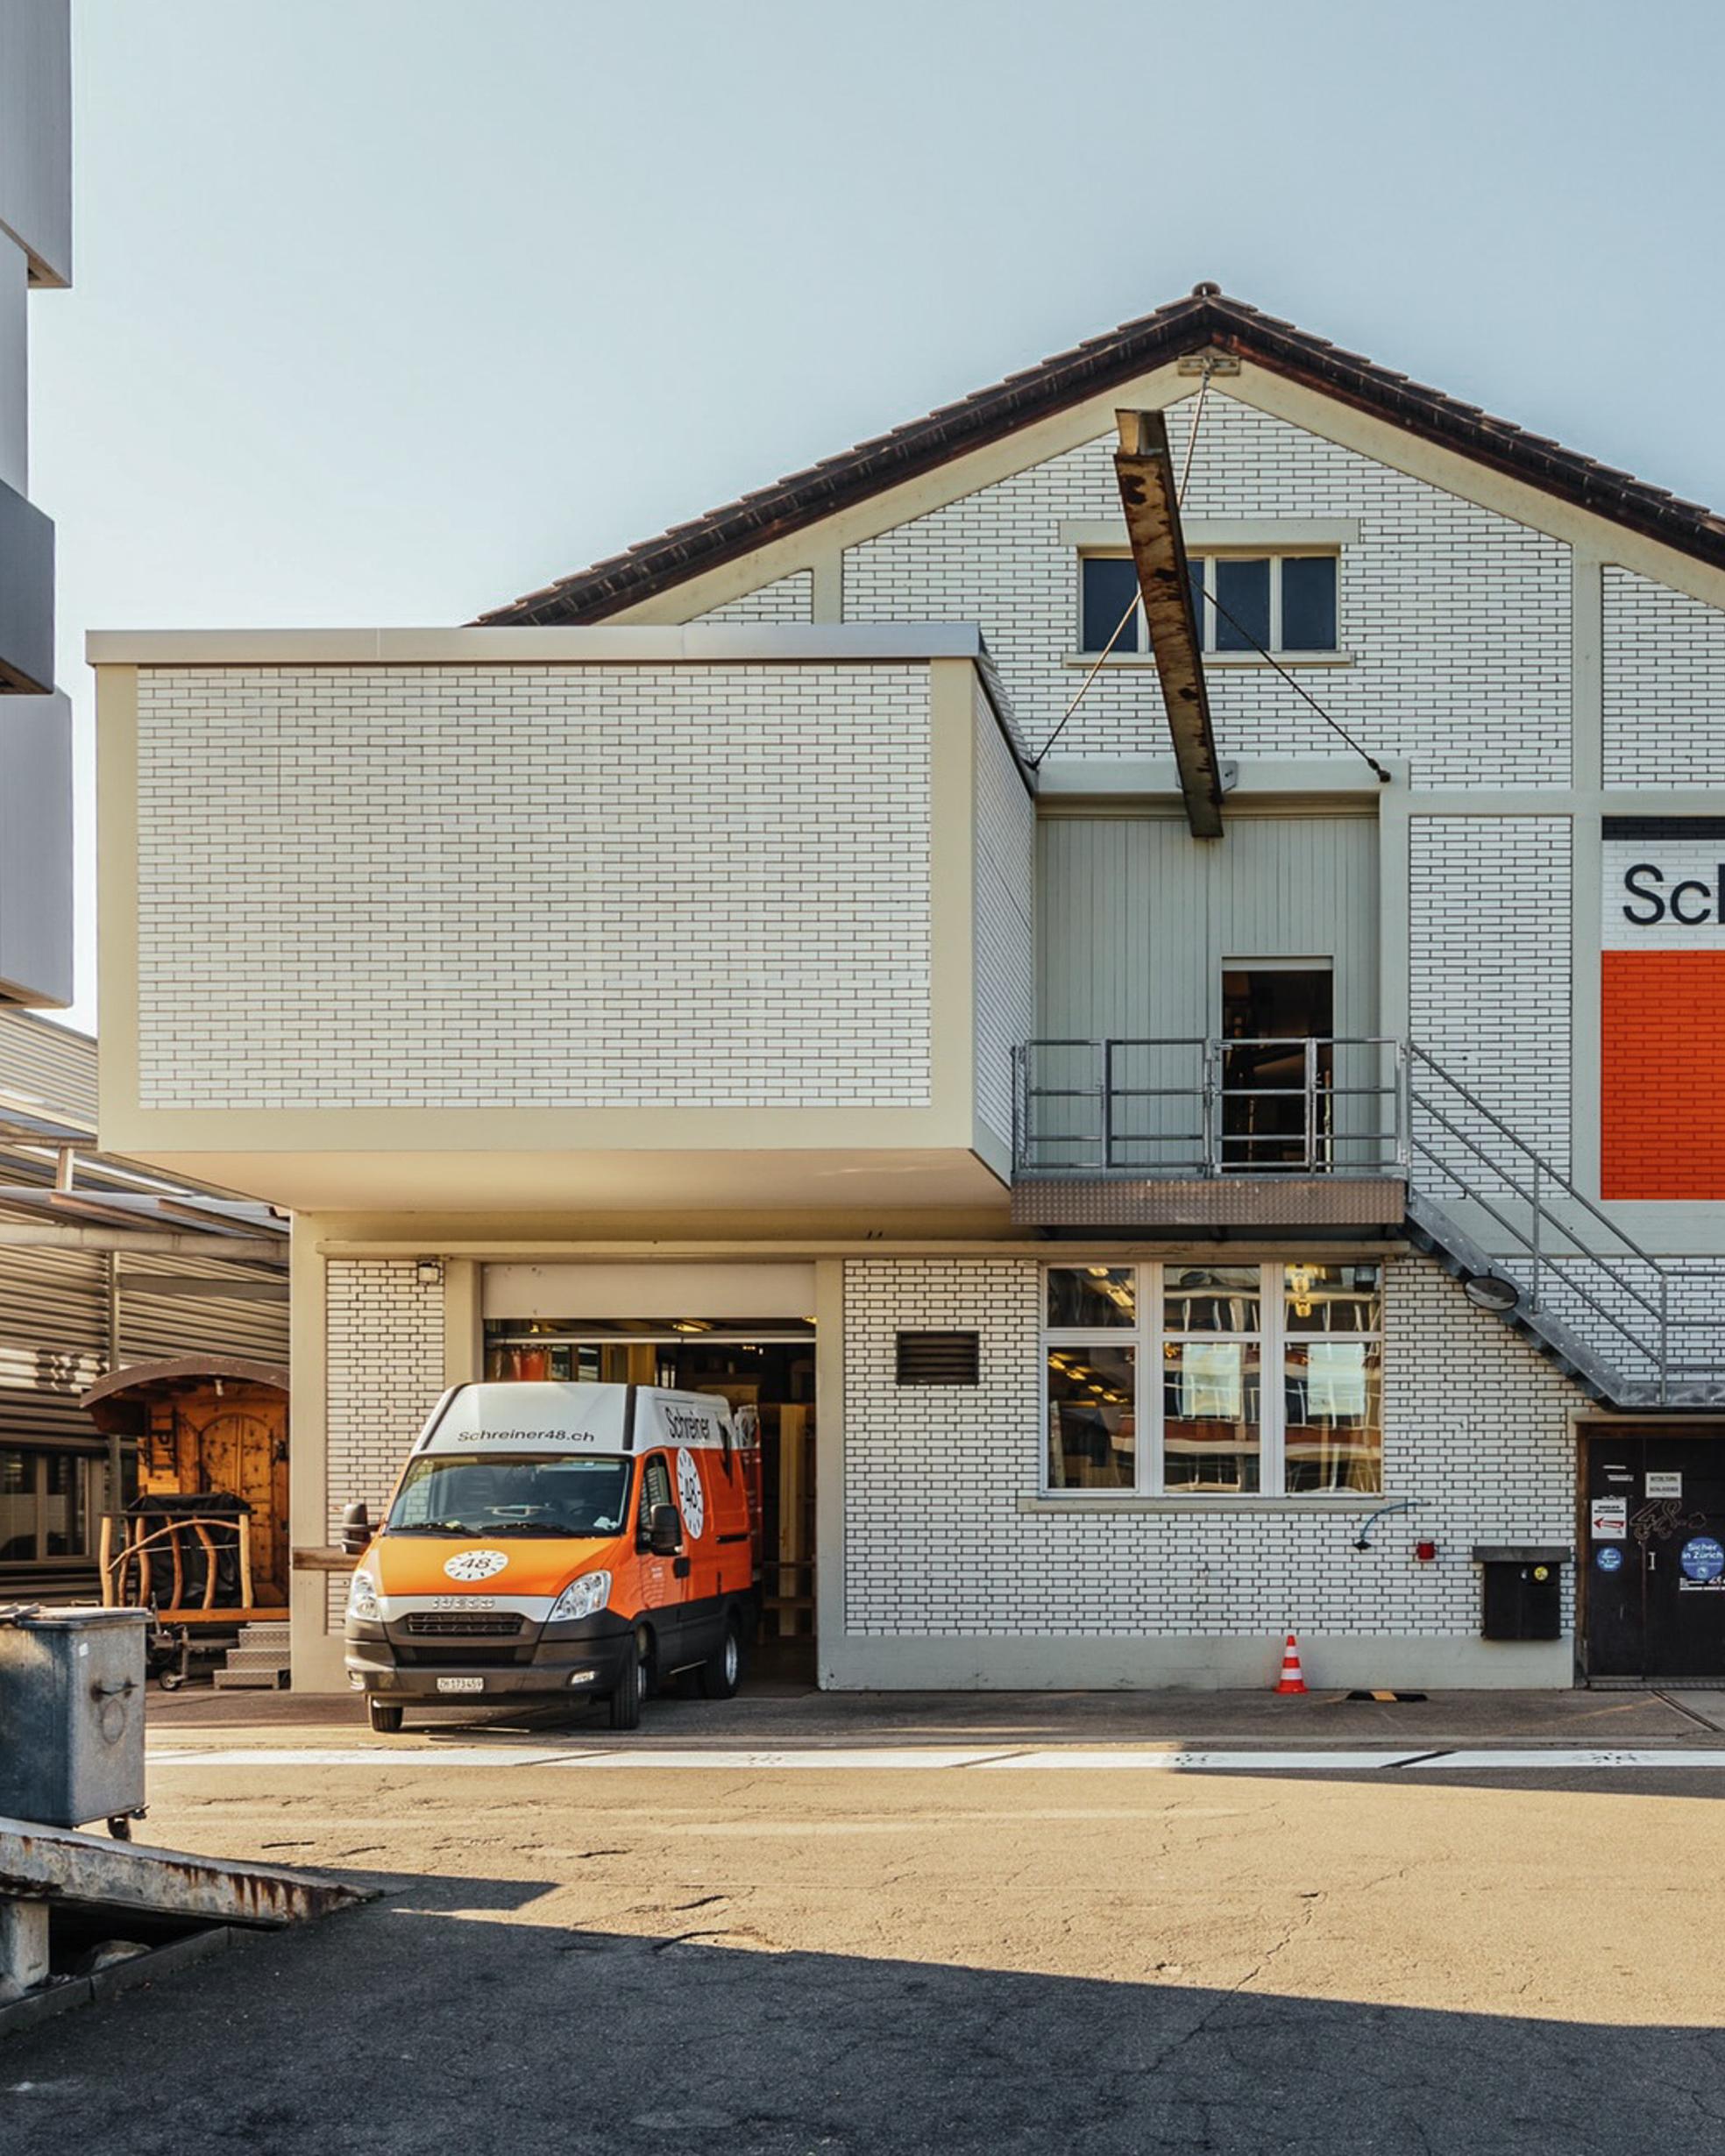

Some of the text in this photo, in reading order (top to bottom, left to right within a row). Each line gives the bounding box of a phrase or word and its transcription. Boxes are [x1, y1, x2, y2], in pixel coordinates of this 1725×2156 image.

[1623, 863, 1725, 926] Sc
[665, 1407, 710, 1439] Schreiner
[458, 1429, 594, 1443] Schreiner48.ch
[685, 1478, 699, 1507] 48
[1687, 1543, 1718, 1552] Sicher
[460, 1558, 491, 1569] 48
